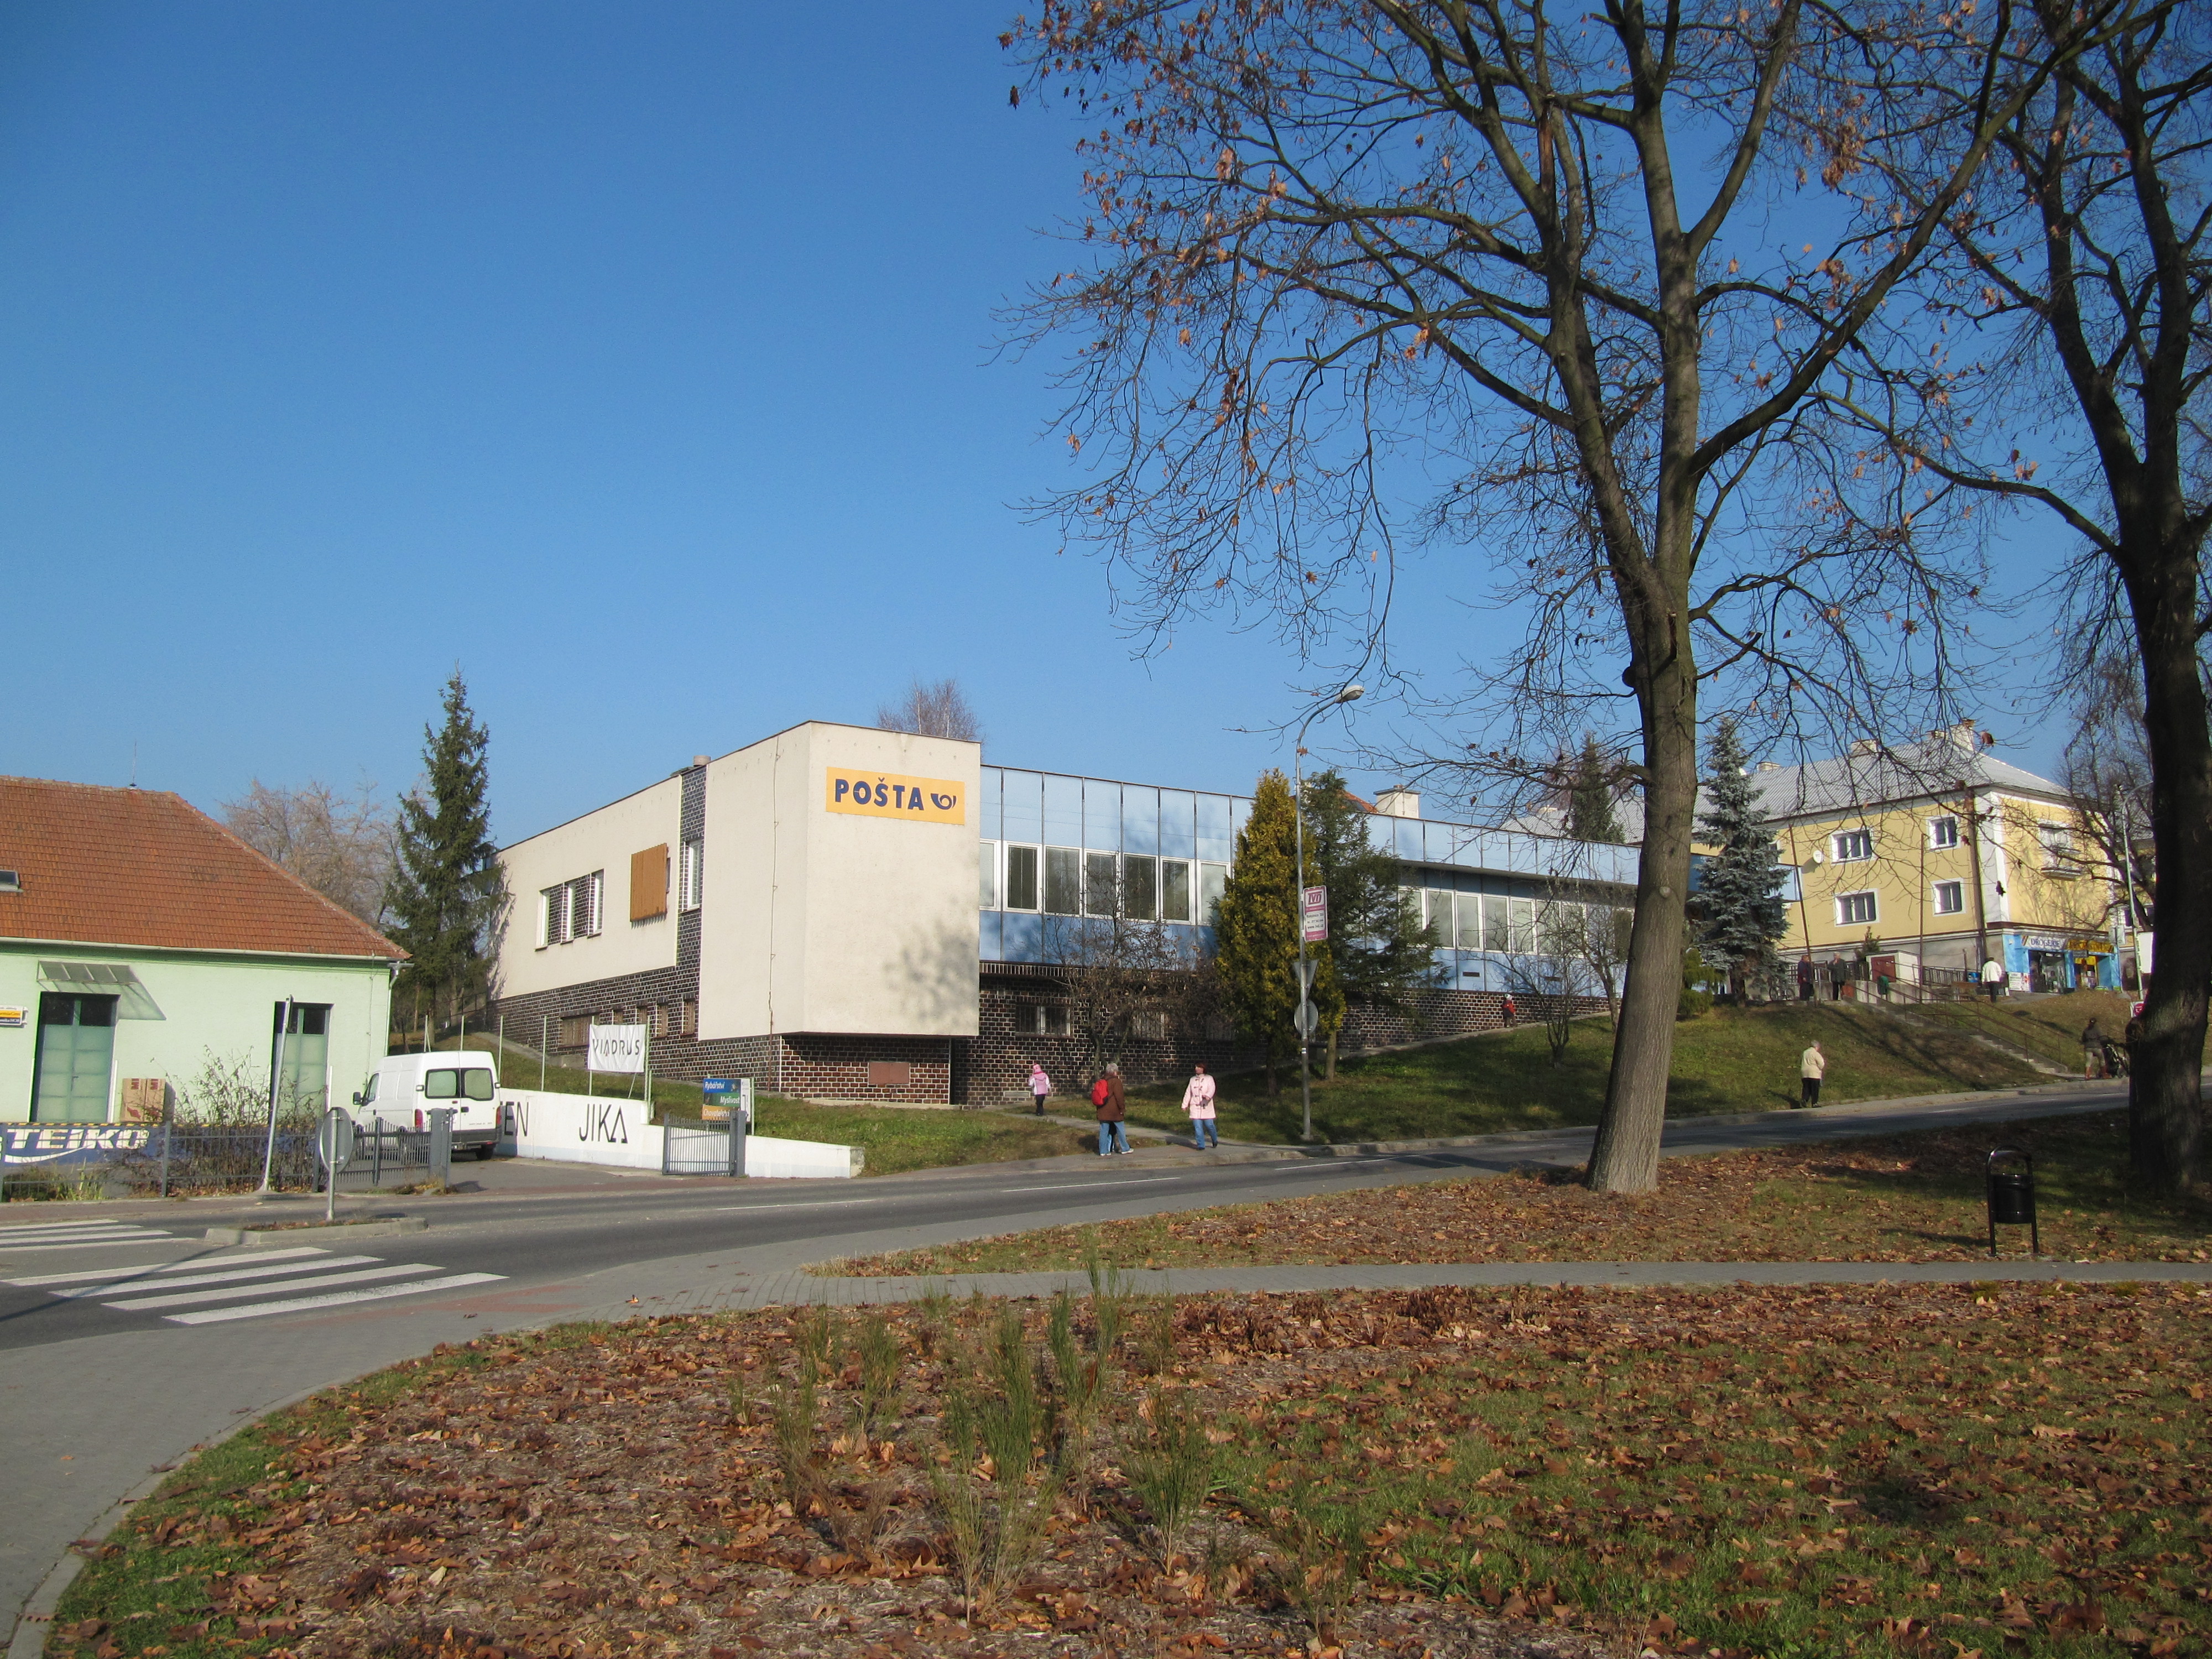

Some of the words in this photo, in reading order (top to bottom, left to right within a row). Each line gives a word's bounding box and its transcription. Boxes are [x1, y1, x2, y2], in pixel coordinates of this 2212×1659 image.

[834, 777, 925, 811] POŠTA
[2031, 938, 2060, 947] DROGERIE
[592, 1039, 640, 1057] VIADRUS
[720, 1095, 740, 1105] Myslivost
[579, 1104, 628, 1144] JIKA
[7, 1129, 149, 1149] TEIKO
